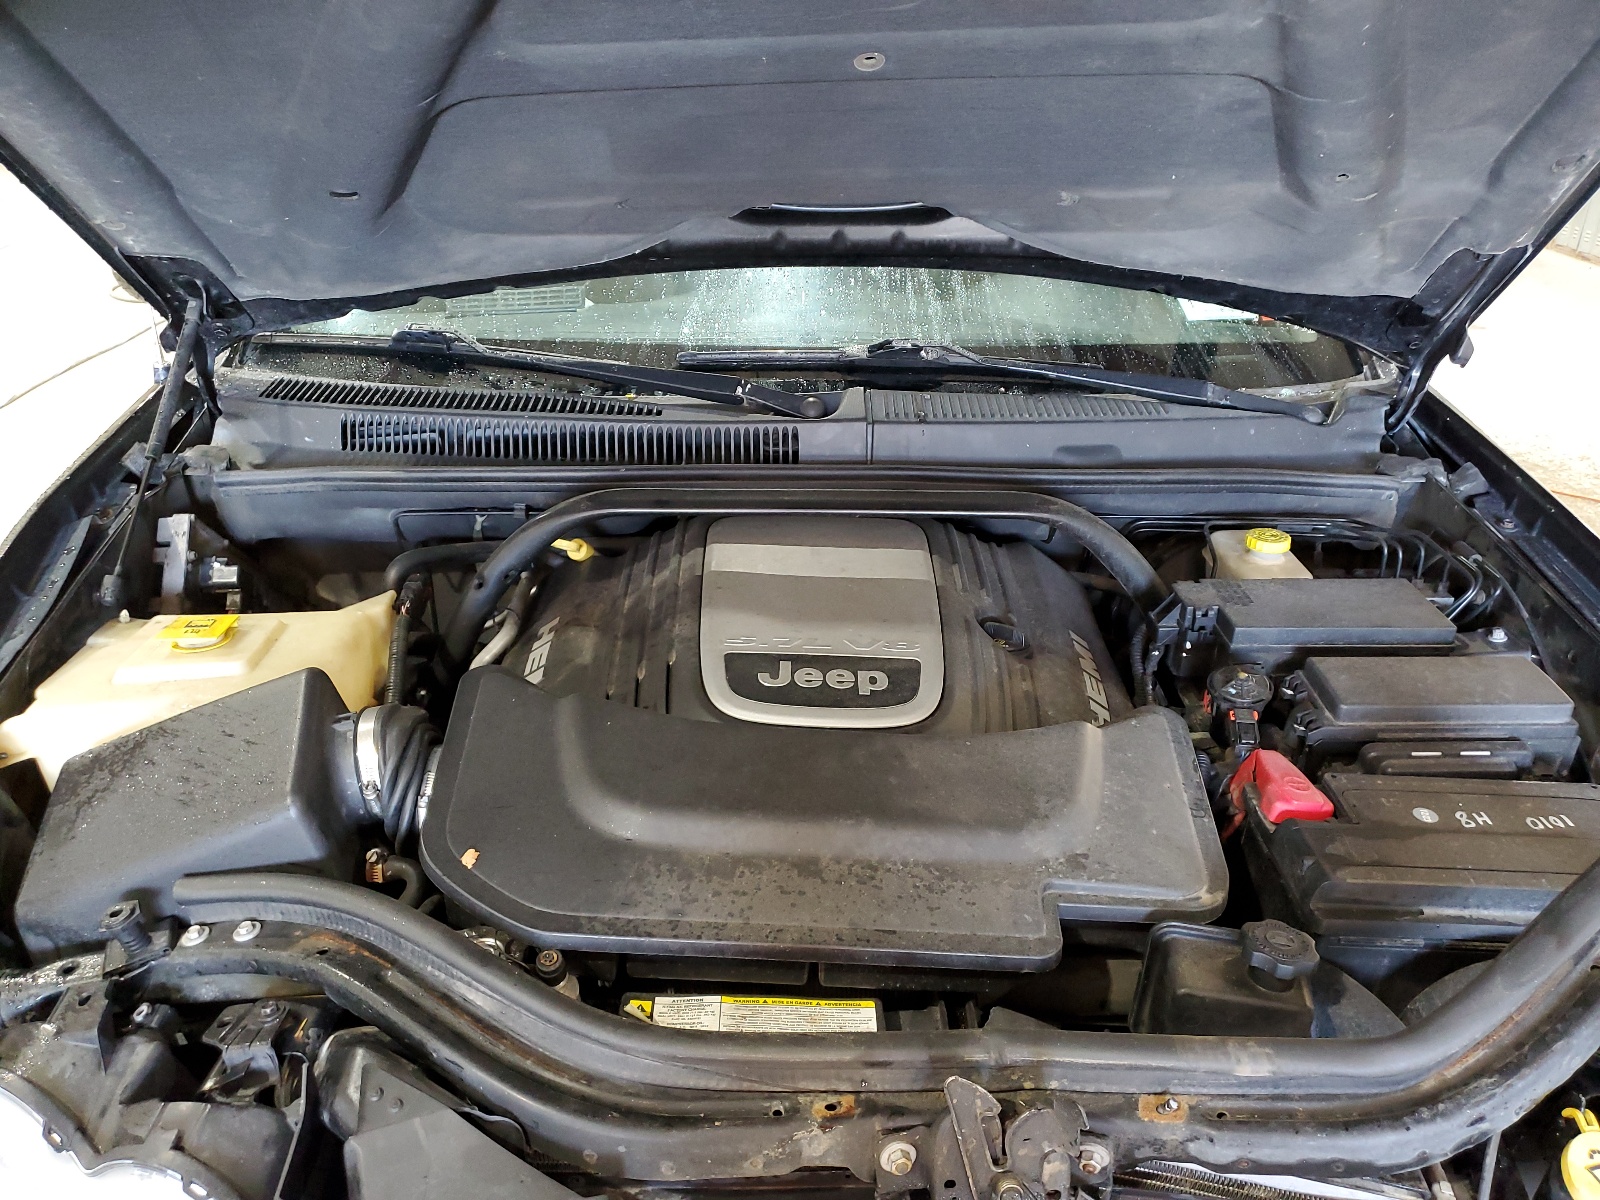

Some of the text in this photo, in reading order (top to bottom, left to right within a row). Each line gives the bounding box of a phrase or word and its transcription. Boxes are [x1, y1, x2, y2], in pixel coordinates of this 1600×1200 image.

[842, 638, 922, 653] V8
[757, 660, 889, 696] Jeep
[1068, 629, 1111, 728] HEMI
